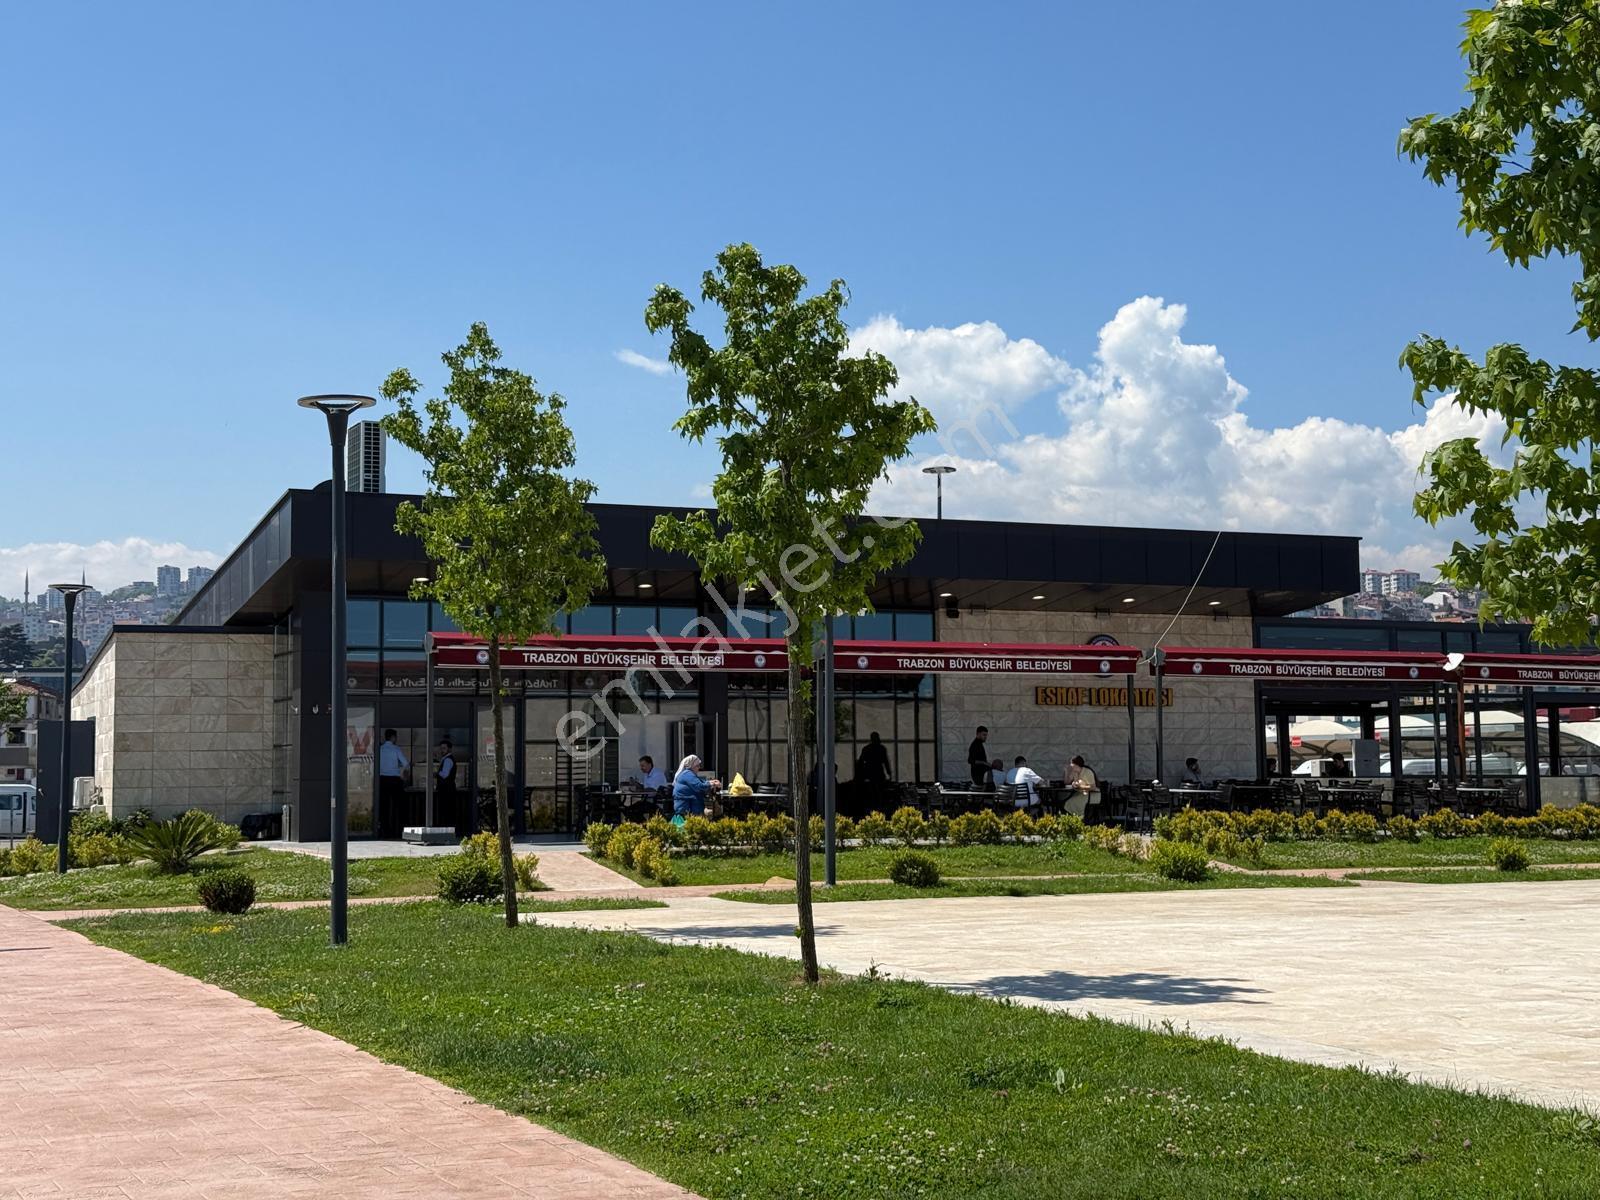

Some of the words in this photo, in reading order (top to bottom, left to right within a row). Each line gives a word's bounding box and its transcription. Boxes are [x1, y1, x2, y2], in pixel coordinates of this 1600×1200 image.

[522, 652, 578, 664] TRABZON
[583, 653, 656, 667] BÜYÜKŞEHİR
[661, 654, 725, 666] BELEDİYESİ
[897, 658, 945, 669] TRABZON
[950, 658, 1013, 671] BÜYÜKŞEHİR
[1016, 660, 1072, 671] BELEDİYESİ
[1229, 664, 1272, 674] TRABZON
[1276, 664, 1333, 677] BÜYÜKŞEHİR
[1335, 666, 1386, 677] BELEDİYESİ
[1517, 670, 1553, 679] TRABZON
